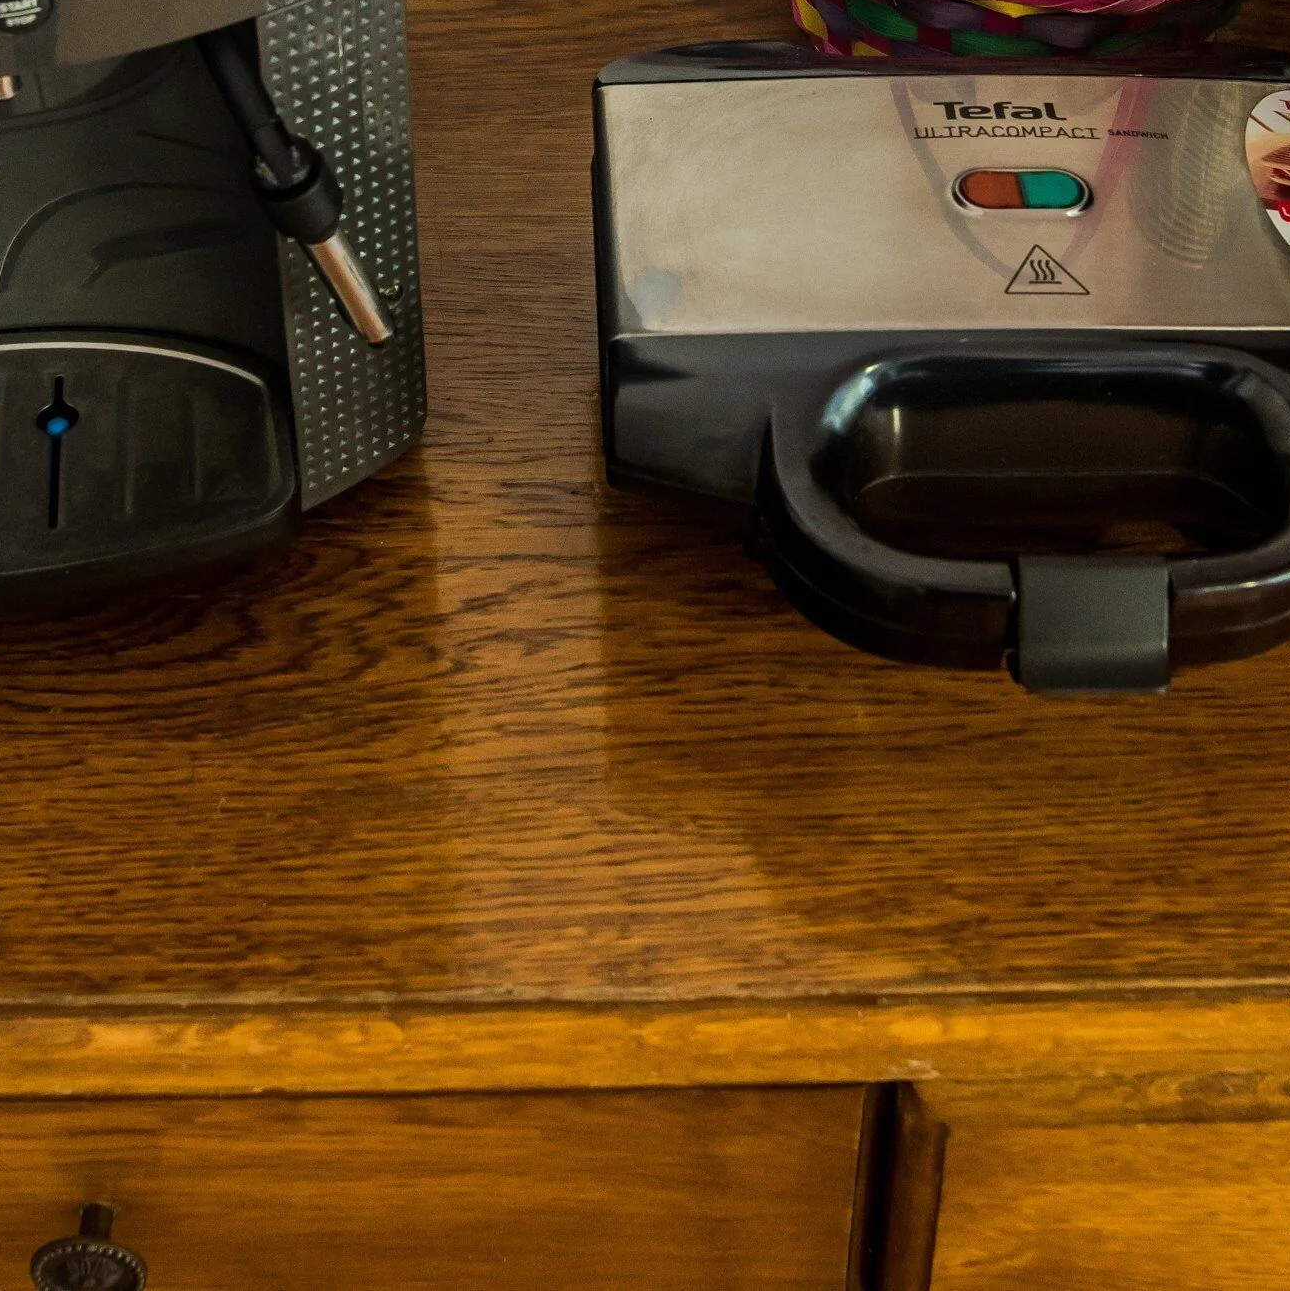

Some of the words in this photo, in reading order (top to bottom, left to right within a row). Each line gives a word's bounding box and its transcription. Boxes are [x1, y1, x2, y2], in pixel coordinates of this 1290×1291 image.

[933, 101, 1067, 121] Tefal
[913, 125, 1101, 140] ULTRACOMPACT
[1107, 129, 1169, 140] SANDWICH
